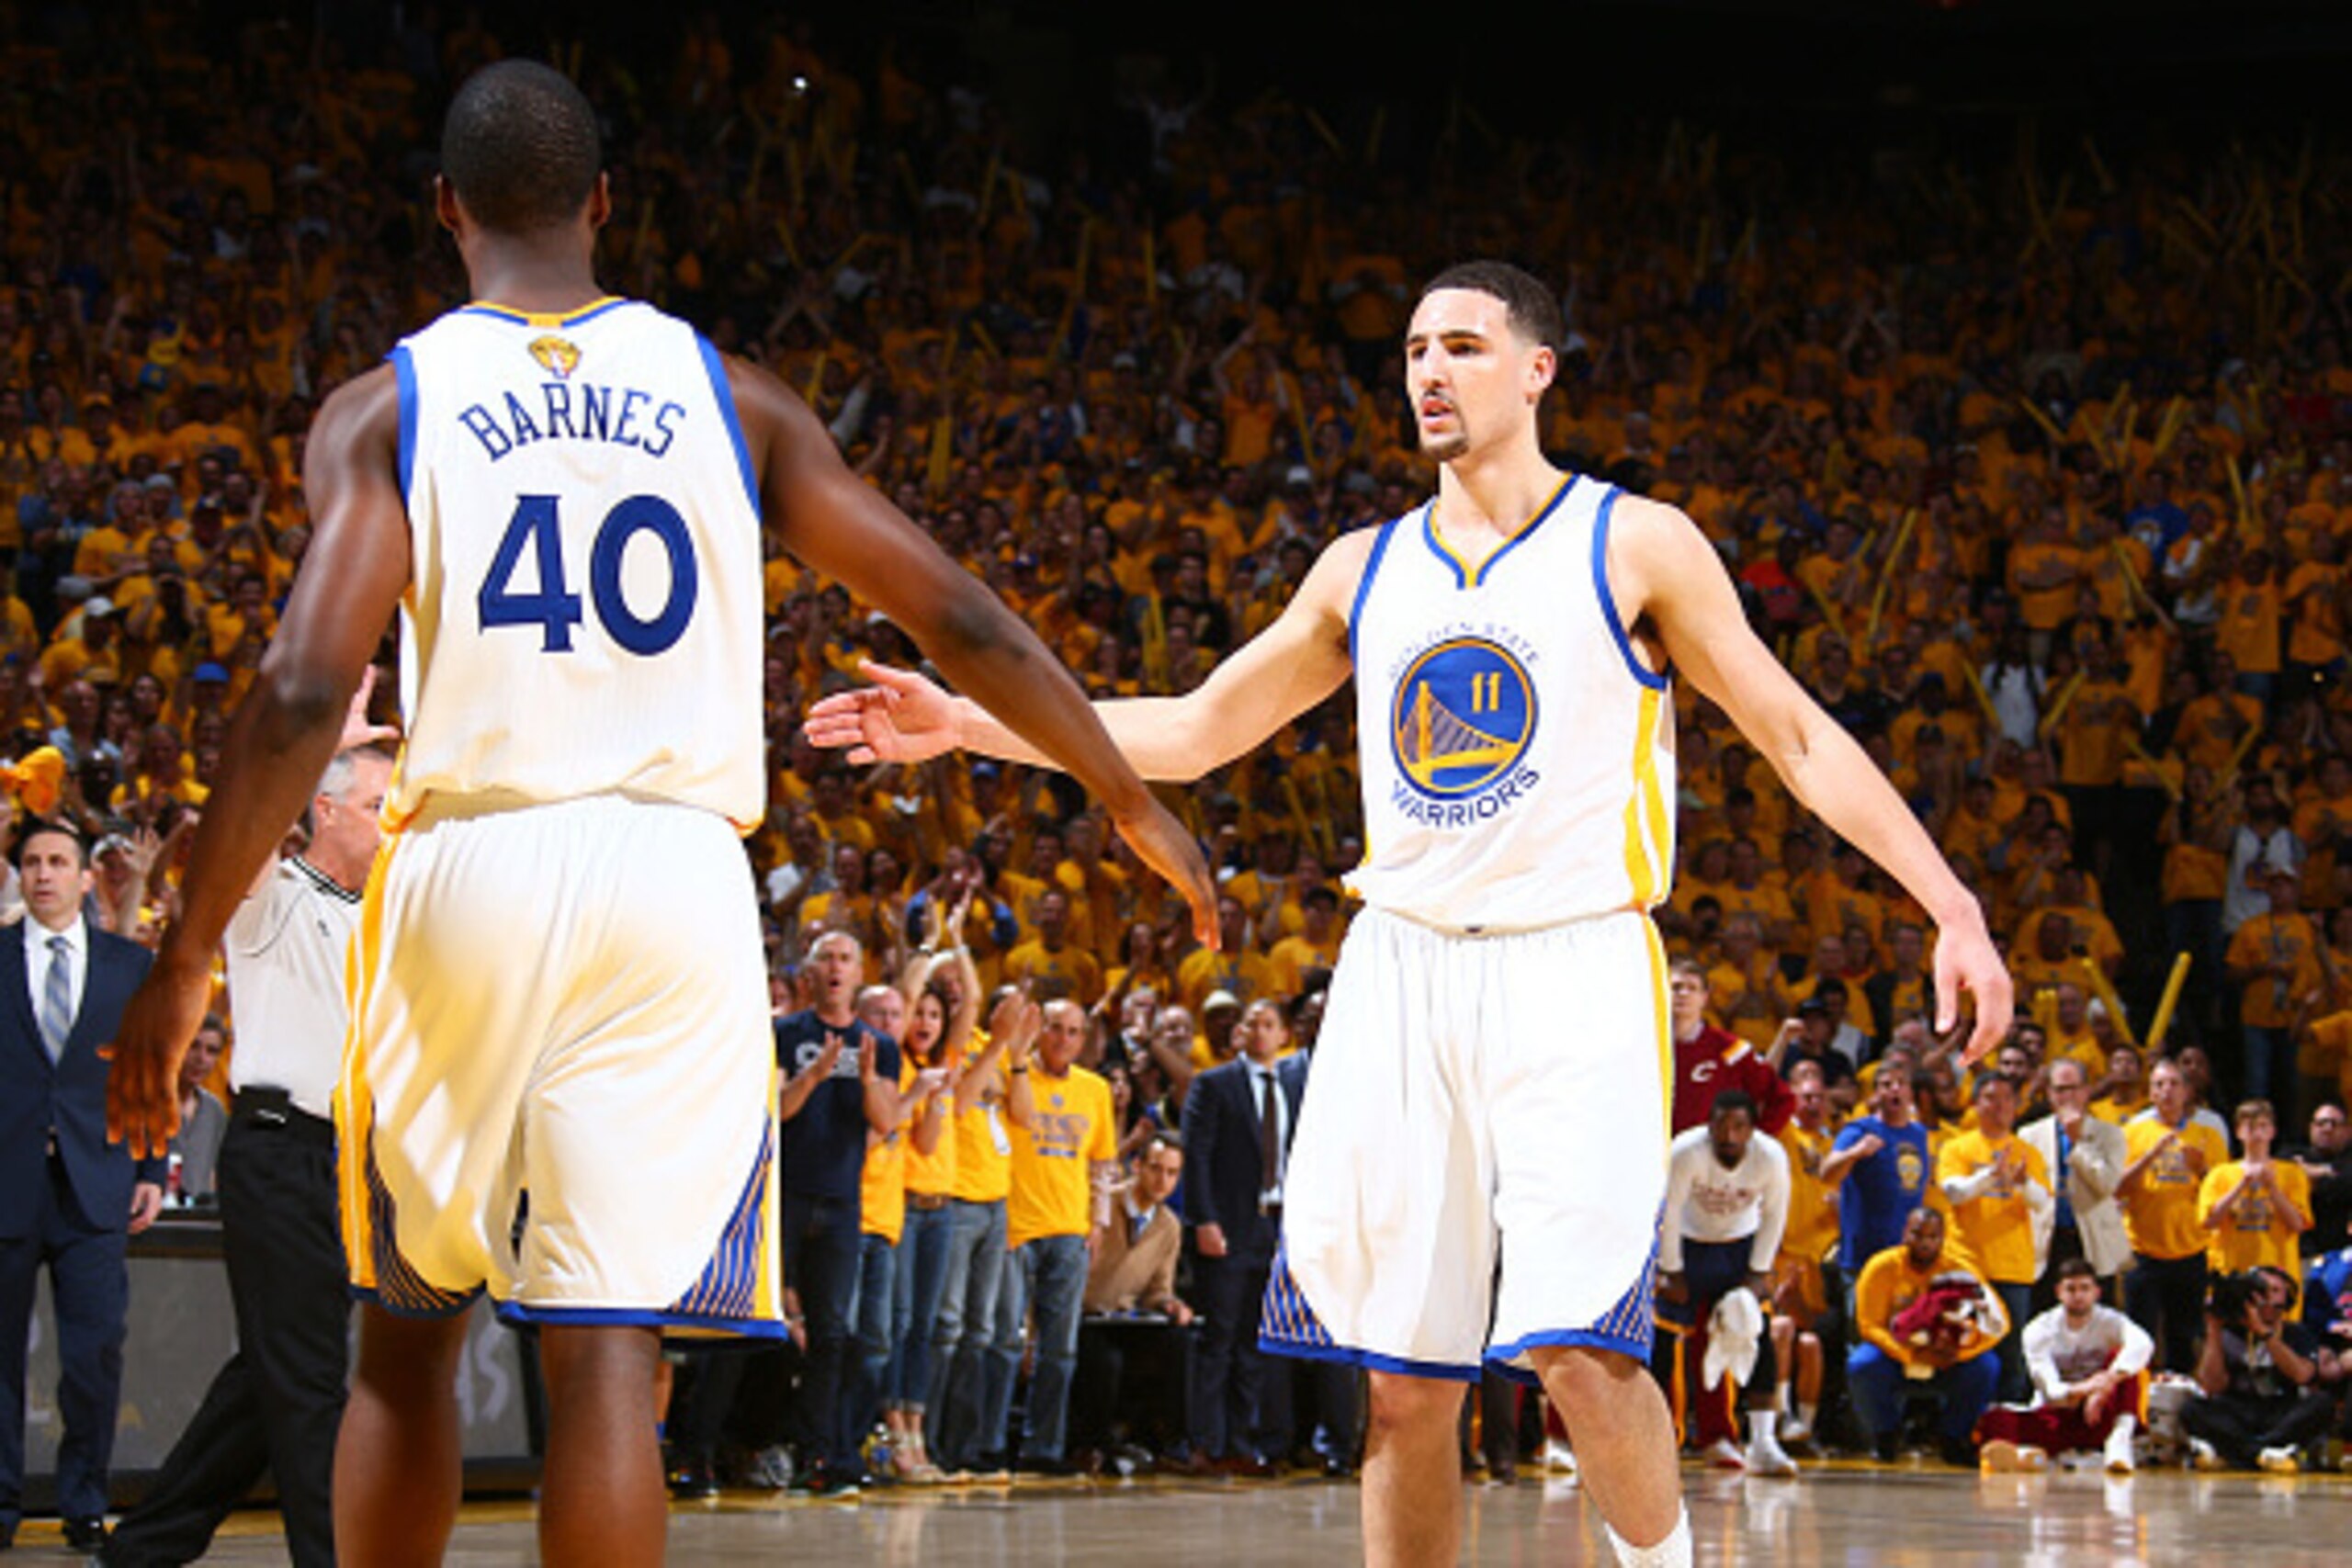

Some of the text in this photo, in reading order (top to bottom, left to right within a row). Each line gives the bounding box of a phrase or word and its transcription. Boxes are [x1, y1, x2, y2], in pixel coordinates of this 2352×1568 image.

[458, 382, 686, 461] BARNES
[477, 493, 698, 657] 40
[1472, 671, 1502, 713] 11
[1390, 764, 1541, 829] WARRIORS
